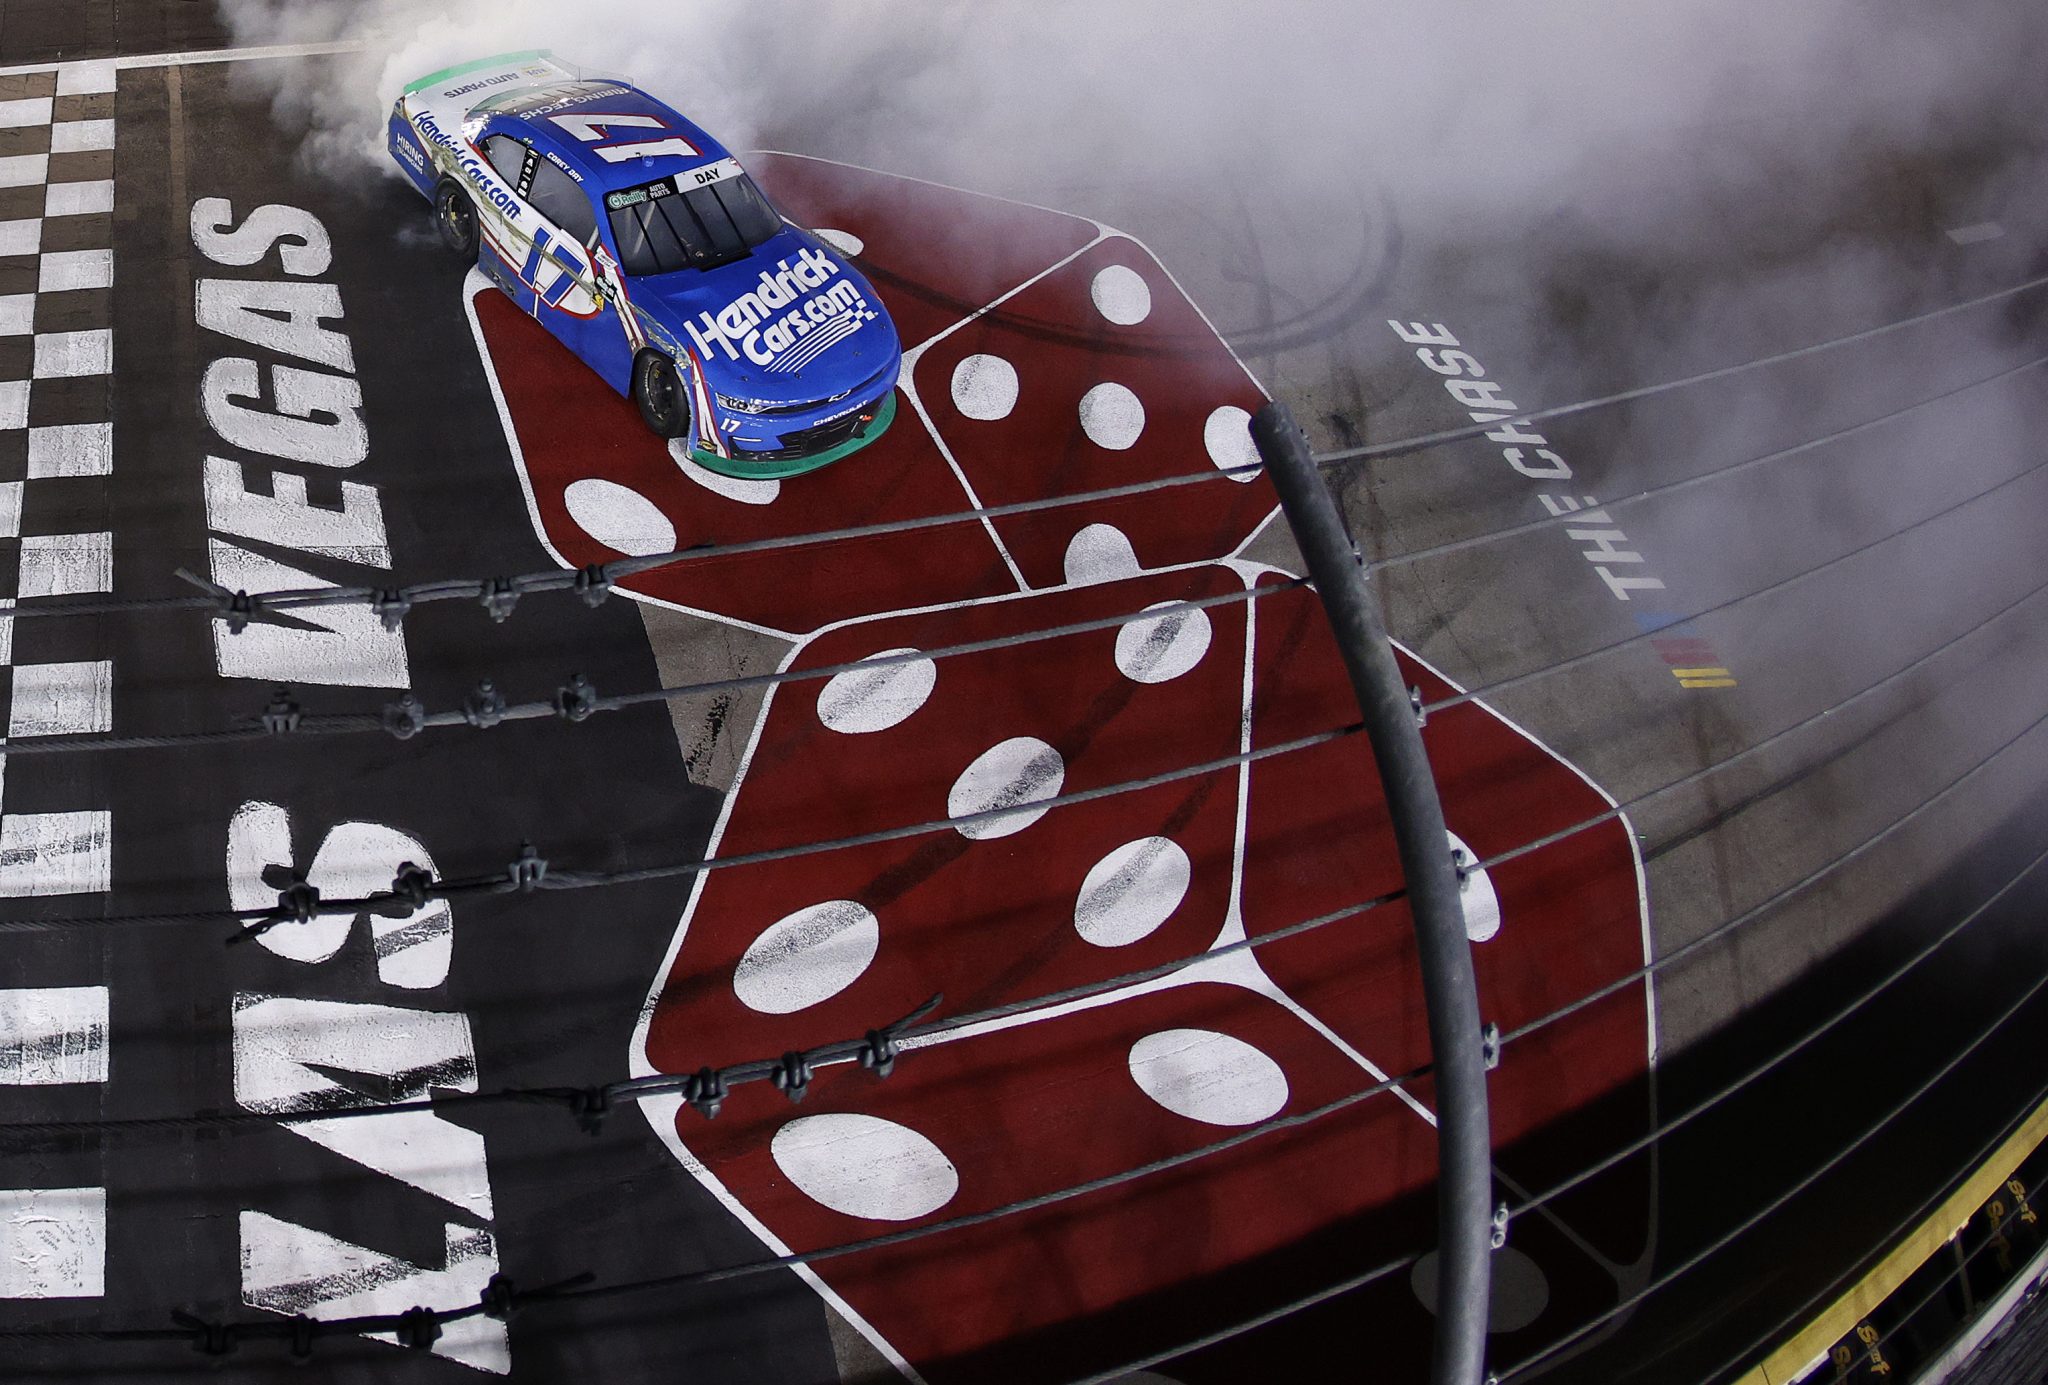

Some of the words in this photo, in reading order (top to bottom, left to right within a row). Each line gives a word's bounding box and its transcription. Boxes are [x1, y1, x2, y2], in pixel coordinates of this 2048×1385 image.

[443, 81, 487, 99] PARTS
[486, 72, 519, 85] AUTO
[573, 87, 631, 104] HIRING
[519, 98, 574, 121] TECHS
[396, 132, 424, 167] HIRING
[548, 113, 703, 163] 17
[546, 151, 571, 171] COREY
[568, 168, 584, 183] DAY
[694, 168, 721, 184] DAY
[608, 190, 648, 209] O'Reilly
[649, 182, 666, 192] AUTO
[650, 188, 671, 199] PARTS
[519, 225, 587, 308] 17
[683, 247, 840, 362] Hendrick
[742, 279, 862, 367] Cars.com
[1386, 319, 1574, 480] CHASE
[720, 417, 742, 433] 17
[812, 400, 869, 427] CHEVROLET
[190, 196, 412, 690] VEGAS
[1537, 493, 1667, 601] THE
